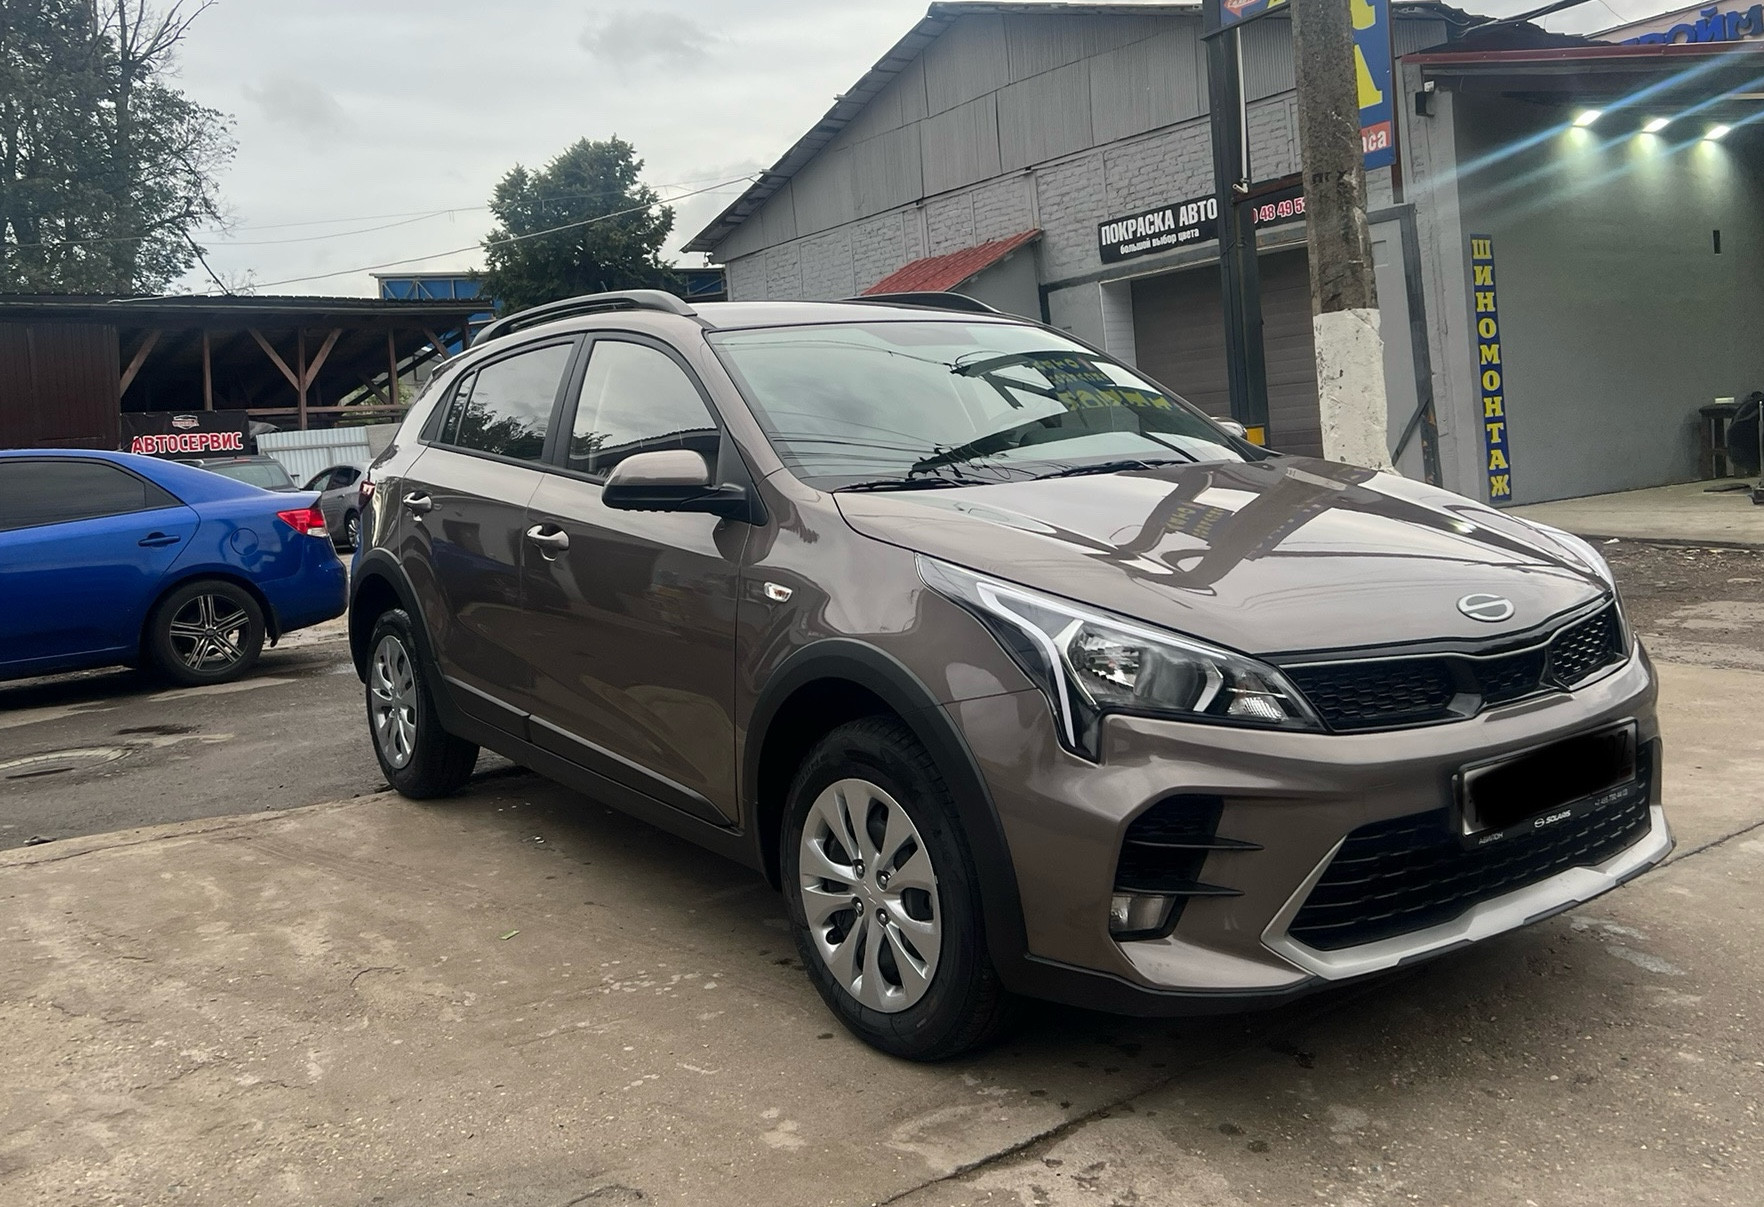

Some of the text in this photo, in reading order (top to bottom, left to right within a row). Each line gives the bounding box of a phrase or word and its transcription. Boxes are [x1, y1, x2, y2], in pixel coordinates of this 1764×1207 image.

[1101, 198, 1218, 245] ПОКРАСКА АВТО
[1259, 204, 1276, 221] 48
[1277, 199, 1294, 218] 49
[1120, 228, 1200, 255] большой выбор цвета
[1471, 239, 1510, 497] ШИНОМОНТАЖ
[131, 432, 244, 454] АВТОСЕРВИС
[1545, 809, 1571, 824] SOLARIS
